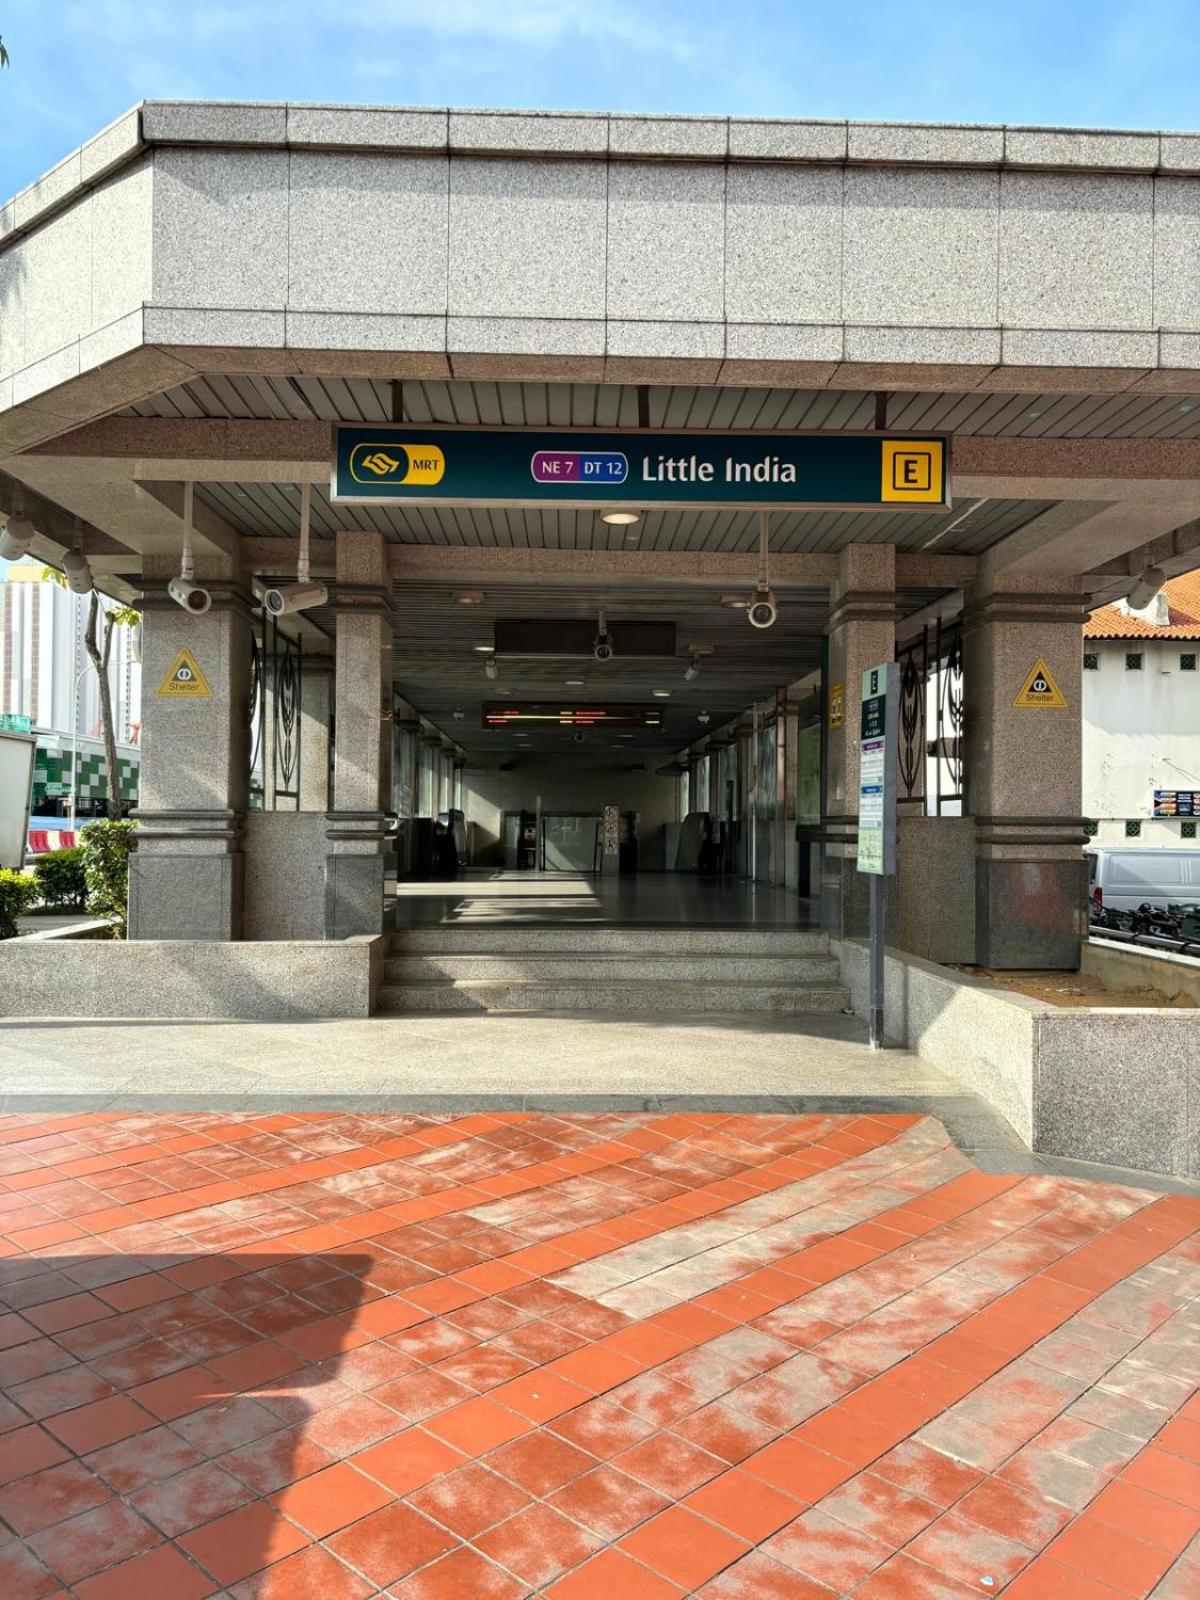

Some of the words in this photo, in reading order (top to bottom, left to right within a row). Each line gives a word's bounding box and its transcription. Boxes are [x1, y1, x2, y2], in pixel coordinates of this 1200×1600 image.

[413, 459, 439, 471] MRT
[542, 461, 561, 474] NE
[565, 461, 573, 475] 7
[584, 462, 602, 475] DT
[606, 462, 622, 475] 12
[642, 455, 714, 482] Little
[725, 455, 797, 483] India
[903, 459, 918, 484] E
[169, 683, 200, 691] Shelter
[1025, 694, 1054, 702] Shelter
